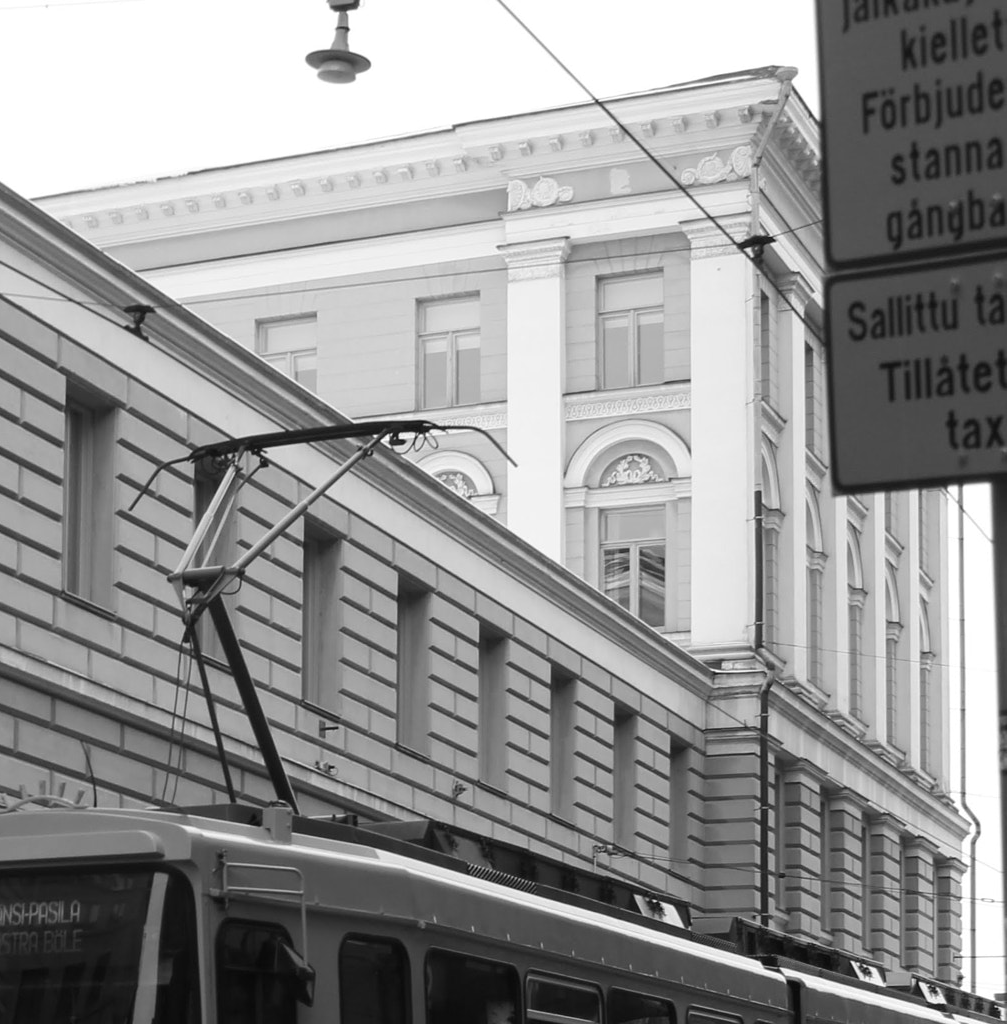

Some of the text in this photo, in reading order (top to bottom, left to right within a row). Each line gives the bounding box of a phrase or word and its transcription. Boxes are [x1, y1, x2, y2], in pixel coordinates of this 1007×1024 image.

[862, 71, 1005, 134] Förbjude
[891, 137, 1004, 185] stanna
[886, 189, 1006, 250] gångba
[847, 285, 1006, 342] Sallittu ta
[879, 349, 1007, 402] Tillåtet
[946, 410, 1005, 450] tax
